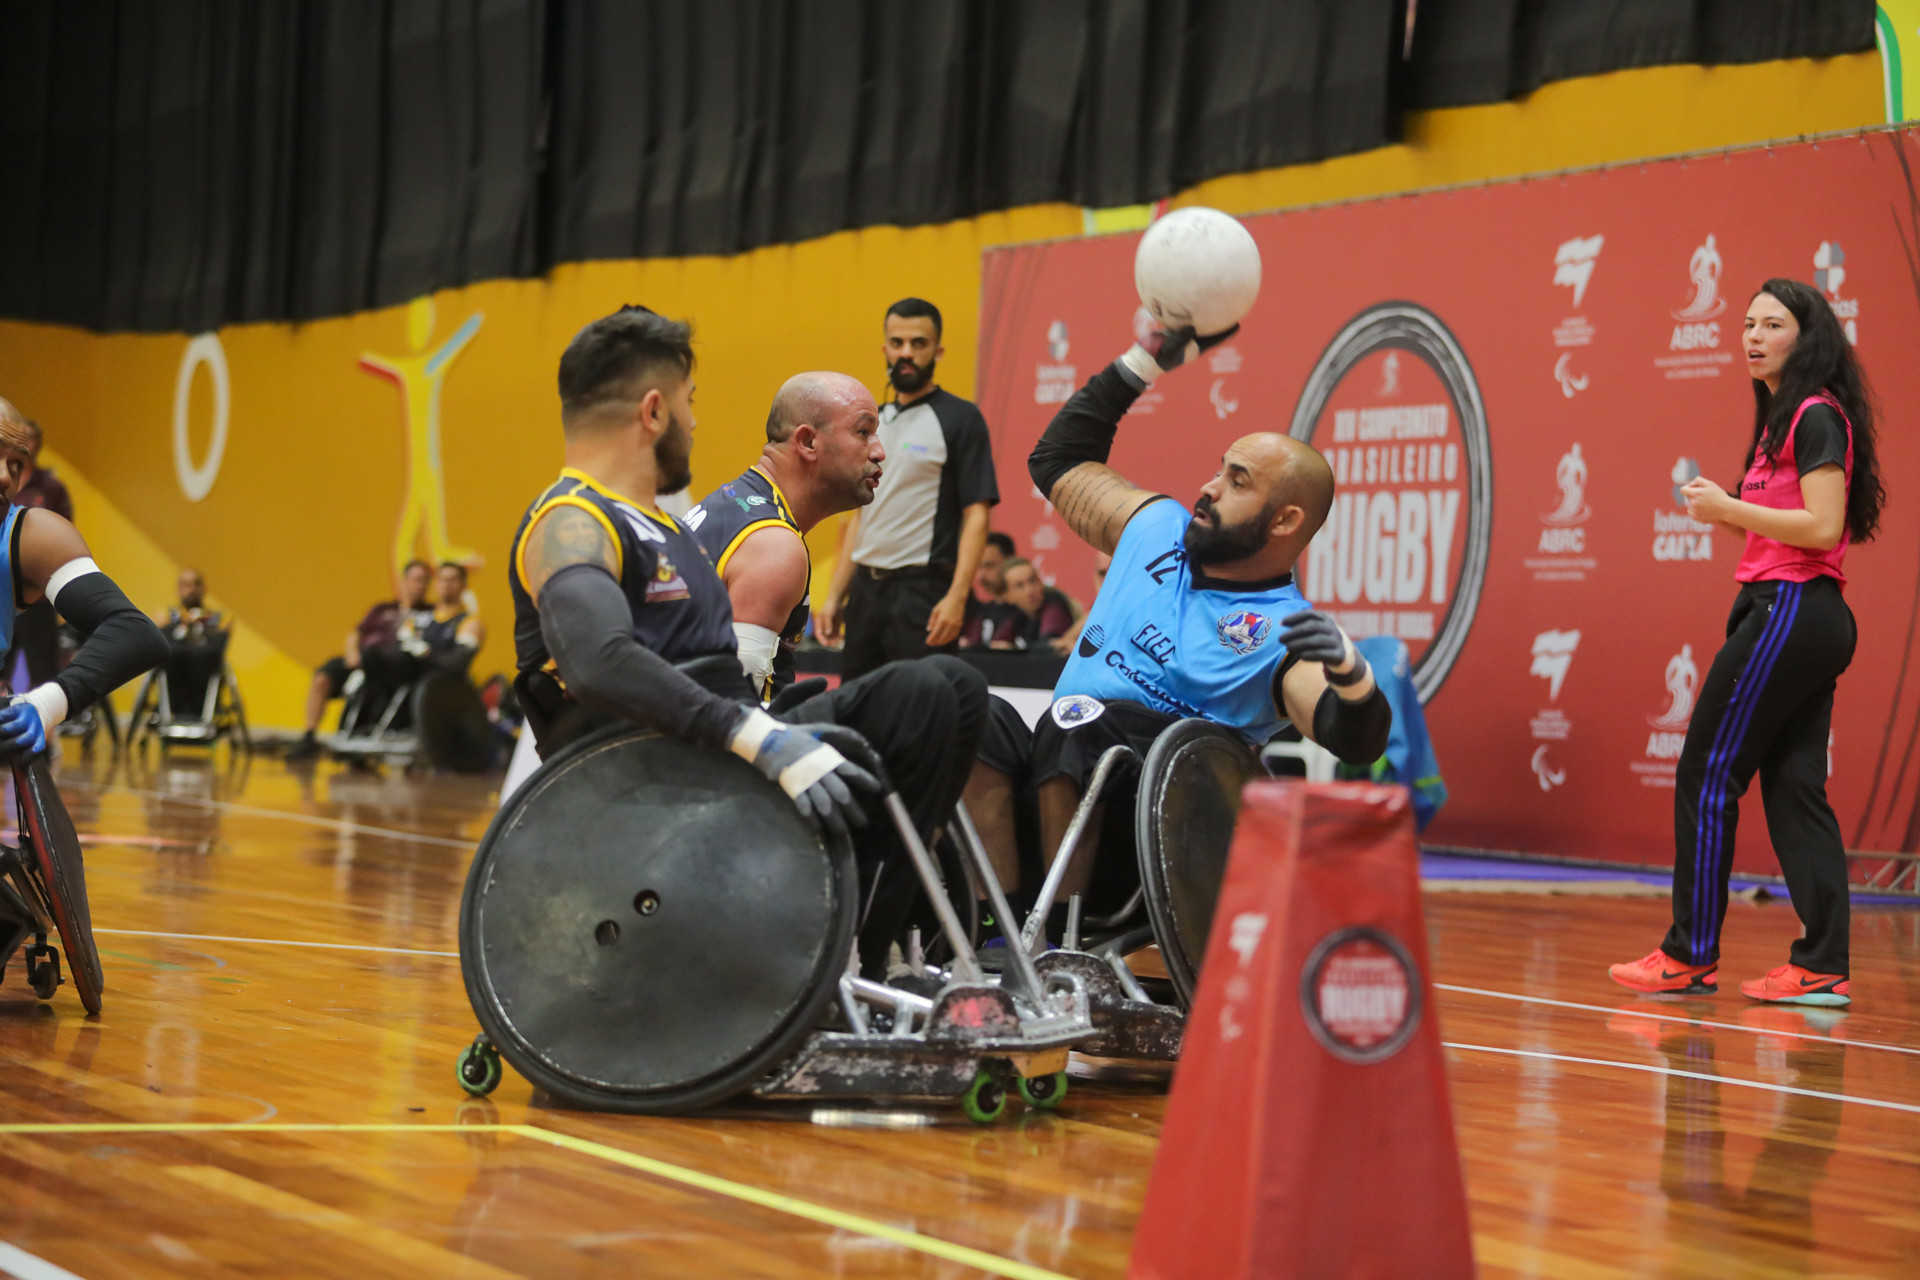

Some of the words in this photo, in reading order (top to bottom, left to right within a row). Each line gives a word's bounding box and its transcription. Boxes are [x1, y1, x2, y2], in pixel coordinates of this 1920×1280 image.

[1670, 322, 1720, 351] ABRC
[1306, 490, 1460, 604] RUGBY
[1538, 528, 1586, 553] ABRC
[1653, 535, 1712, 561] CAIXA
[1646, 731, 1686, 758] ABR
